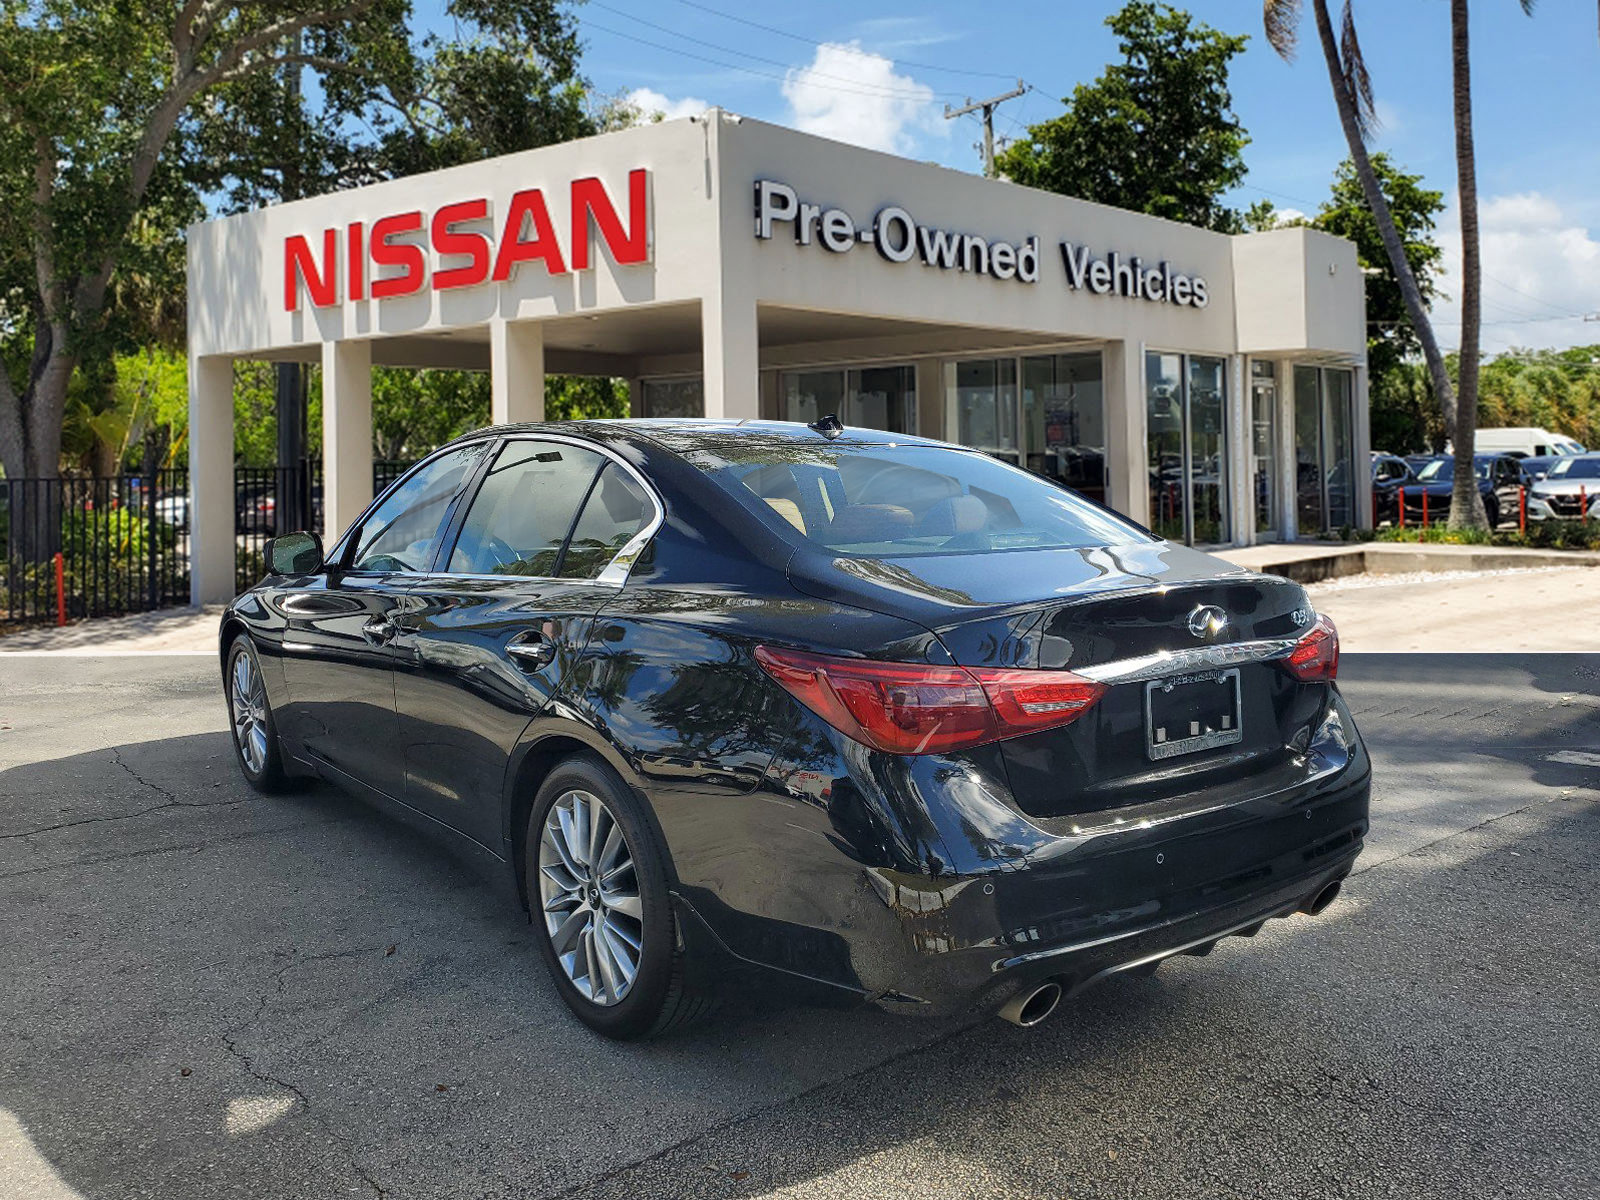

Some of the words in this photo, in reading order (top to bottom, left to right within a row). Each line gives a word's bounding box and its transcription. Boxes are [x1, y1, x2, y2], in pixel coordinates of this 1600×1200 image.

[285, 168, 649, 312] NISSAN
[754, 179, 1040, 284] Pre-Owned
[1060, 241, 1209, 308] Vehicles
